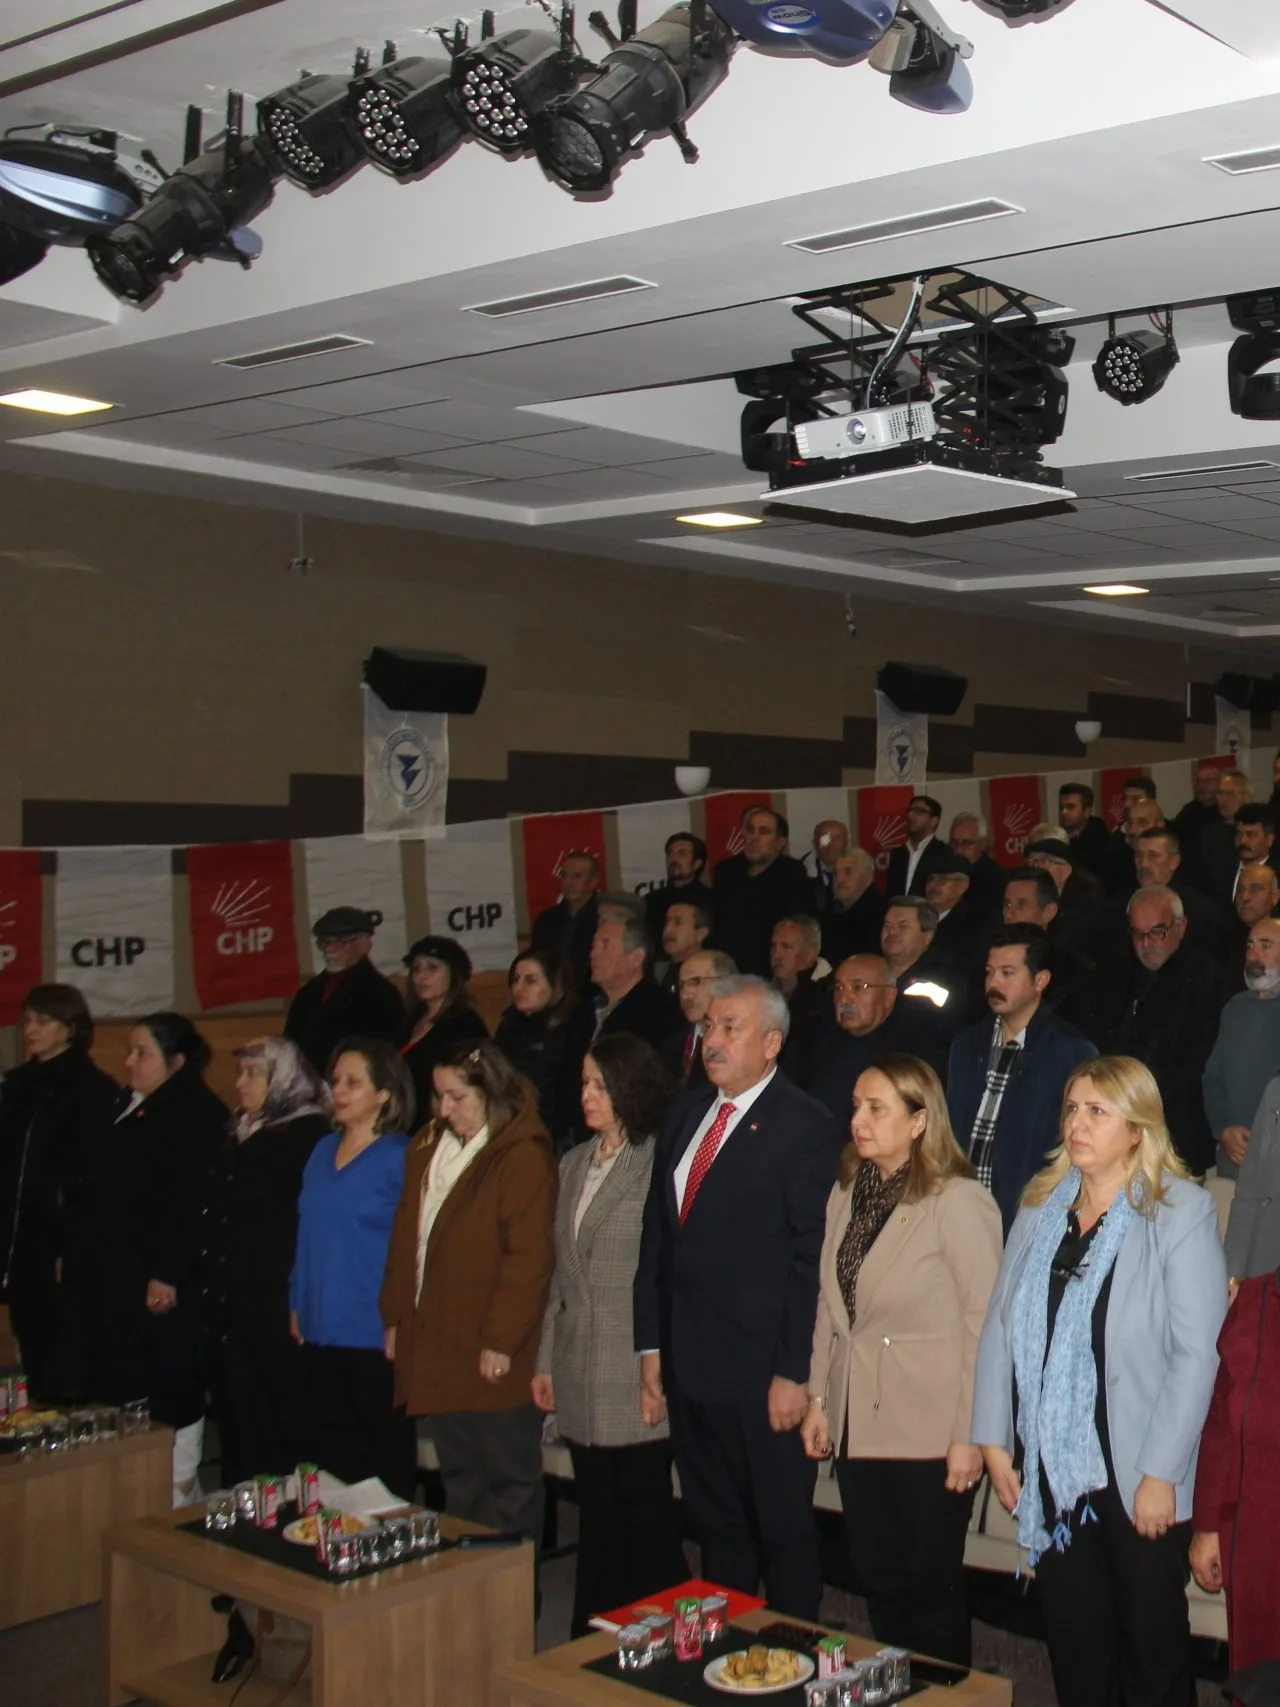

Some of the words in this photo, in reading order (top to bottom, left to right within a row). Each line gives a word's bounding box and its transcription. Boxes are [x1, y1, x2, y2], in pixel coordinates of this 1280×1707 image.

[447, 902, 503, 932] CHP
[71, 936, 146, 968] CHP
[216, 926, 274, 955] CHP
